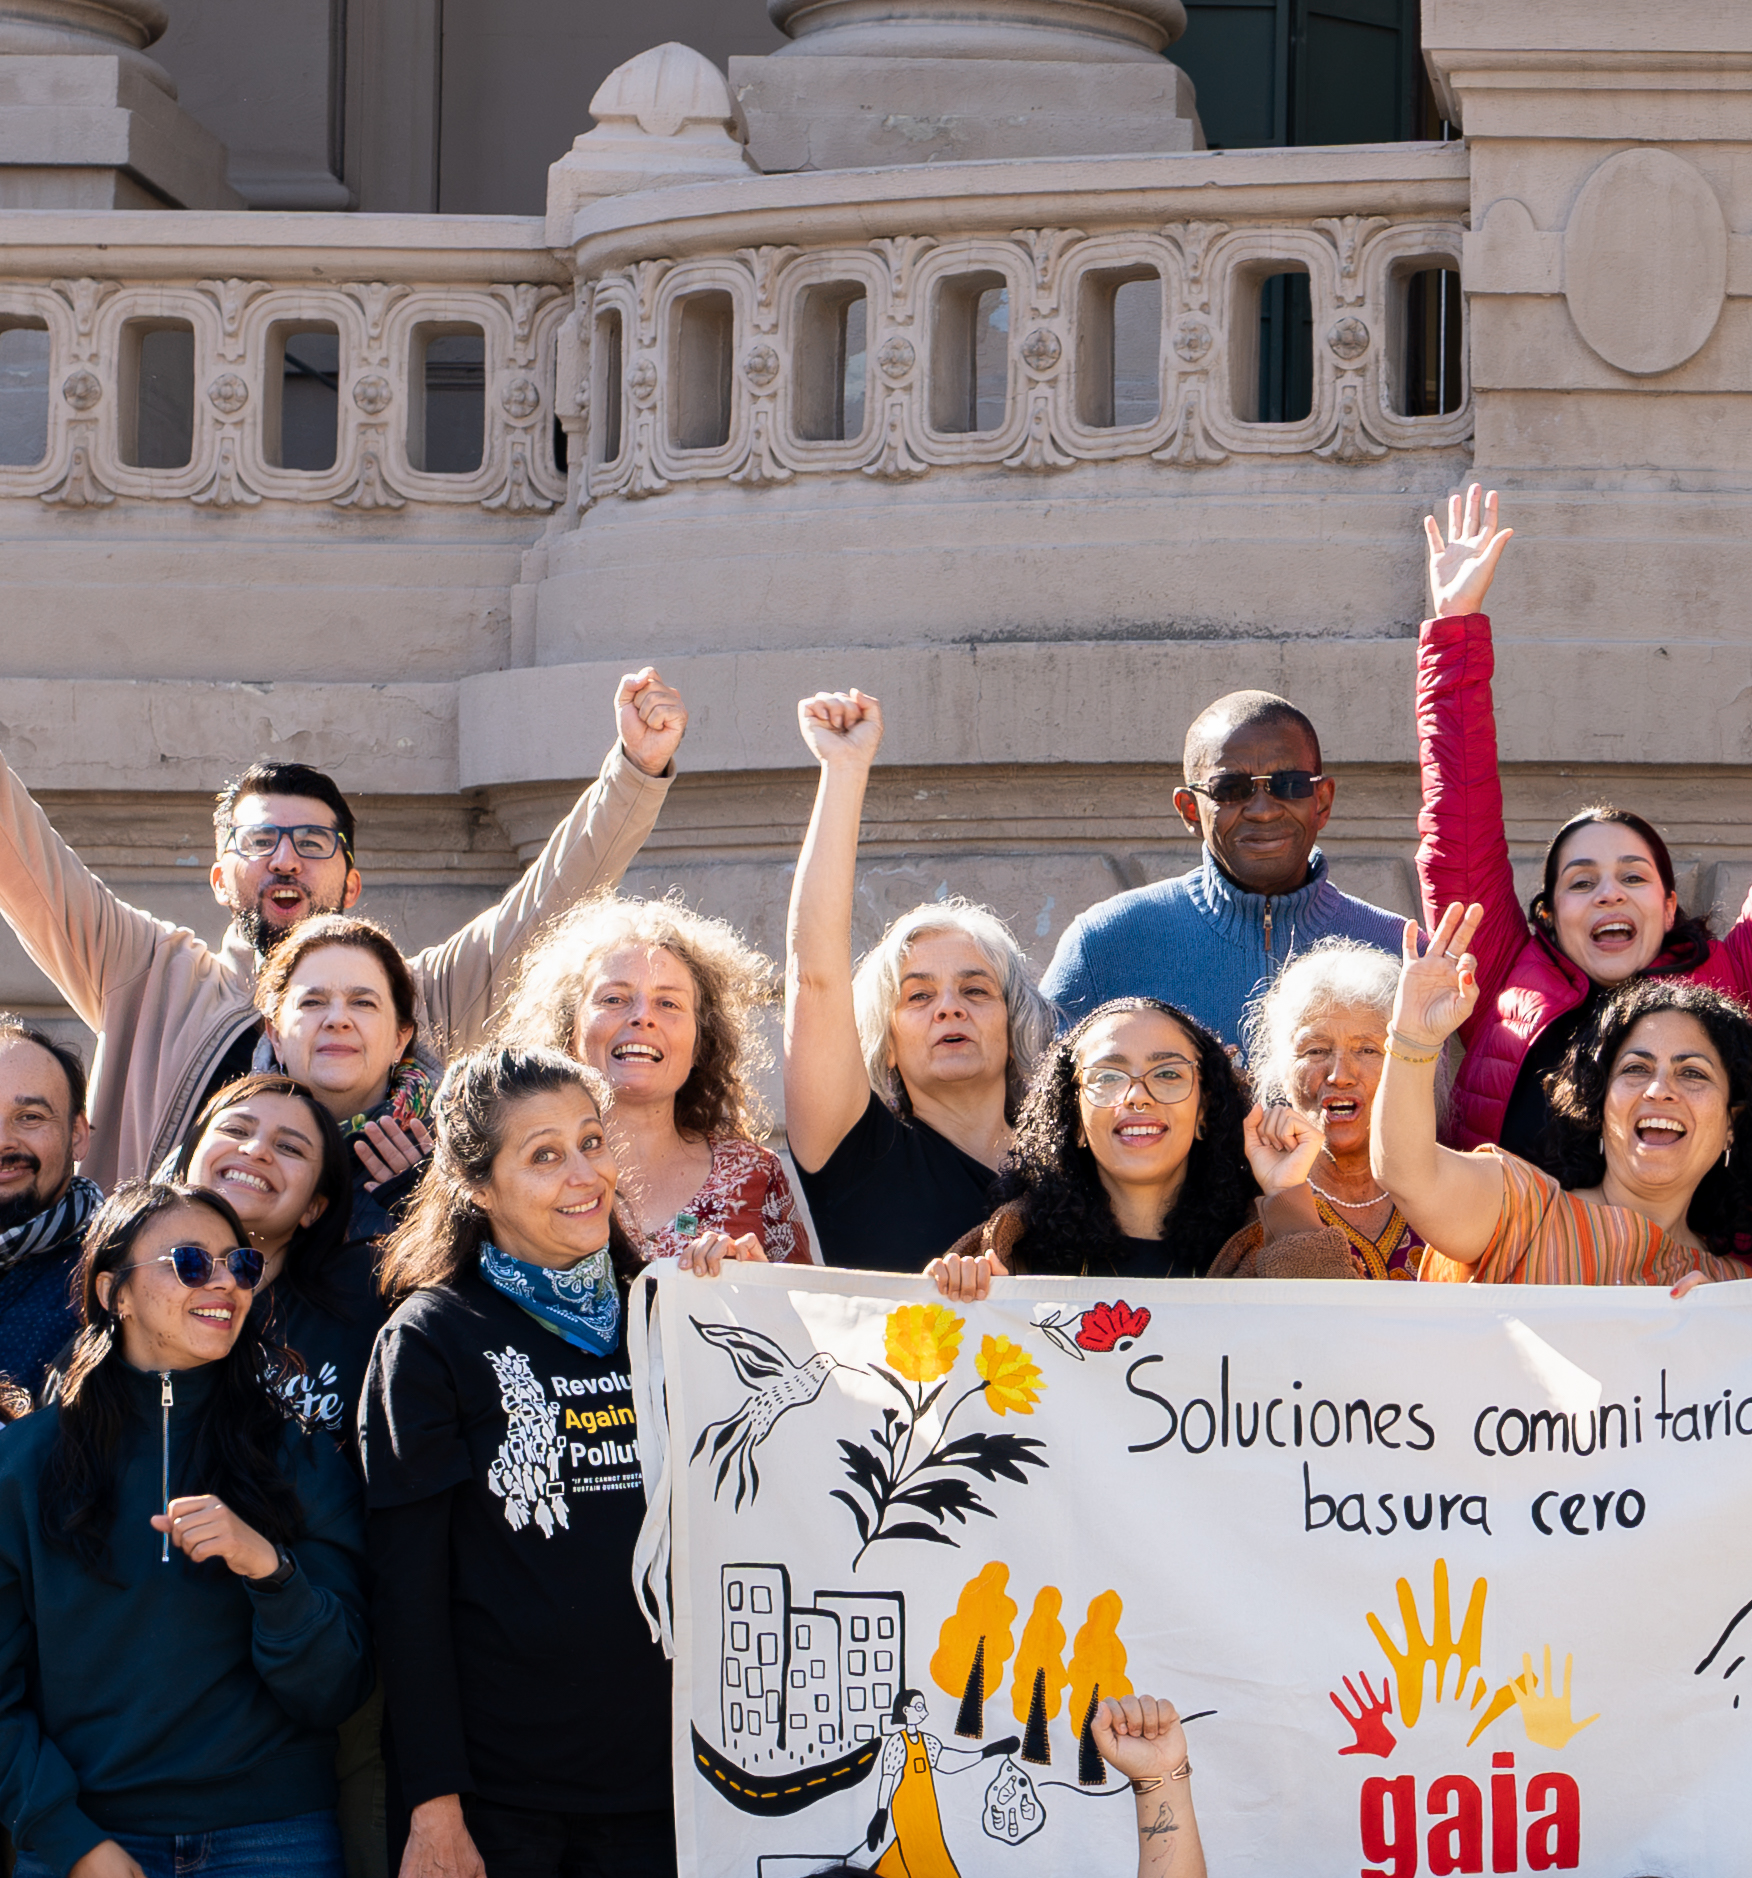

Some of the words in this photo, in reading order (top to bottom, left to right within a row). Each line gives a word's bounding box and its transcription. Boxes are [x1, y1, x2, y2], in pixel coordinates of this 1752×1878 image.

[551, 1371, 632, 1397] Revolu
[1126, 1355, 1435, 1453] Soluciones
[565, 1404, 636, 1434] Again
[570, 1439, 641, 1467] Pollut
[623, 1472, 643, 1481] SUSTA
[1303, 1461, 1492, 1535] basura
[1531, 1488, 1646, 1536] cero
